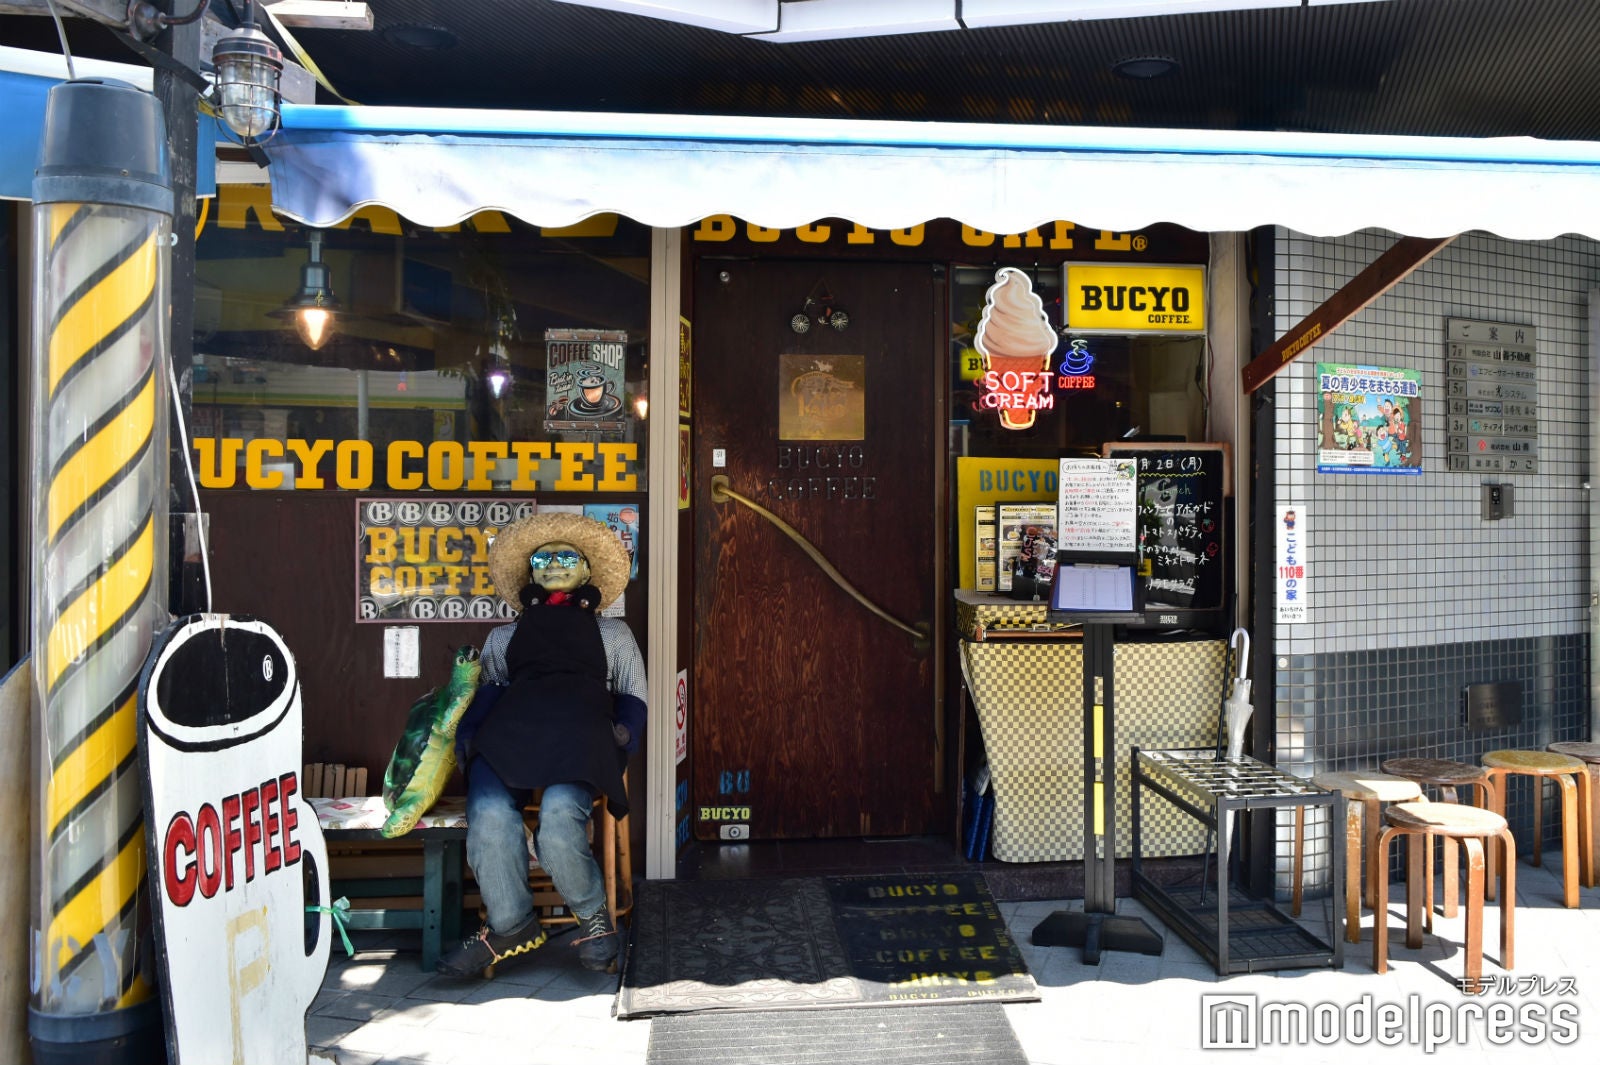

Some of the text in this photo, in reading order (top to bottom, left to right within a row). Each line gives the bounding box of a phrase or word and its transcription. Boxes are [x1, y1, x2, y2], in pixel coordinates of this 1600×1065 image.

[1081, 286, 1189, 312] BUCYO
[1148, 315, 1190, 324] COFFEE
[1282, 323, 1322, 362] BUCYO COFFEE
[549, 343, 623, 370] COFFEE SHOP
[986, 371, 1054, 394] SOFT
[1058, 376, 1095, 389] COFFEE
[1321, 375, 1417, 396] 夏の青少年をまもる運動
[985, 393, 1054, 410] CREAM
[387, 440, 638, 491] COFFEE
[777, 445, 863, 468] BUCYO
[768, 477, 876, 500] COFFEE
[979, 470, 1058, 493] BUCYO
[701, 807, 750, 821] BUCYO
[164, 771, 301, 908] COFFEE
[868, 883, 959, 898] BUCYO
[876, 946, 998, 963] COFFEE
